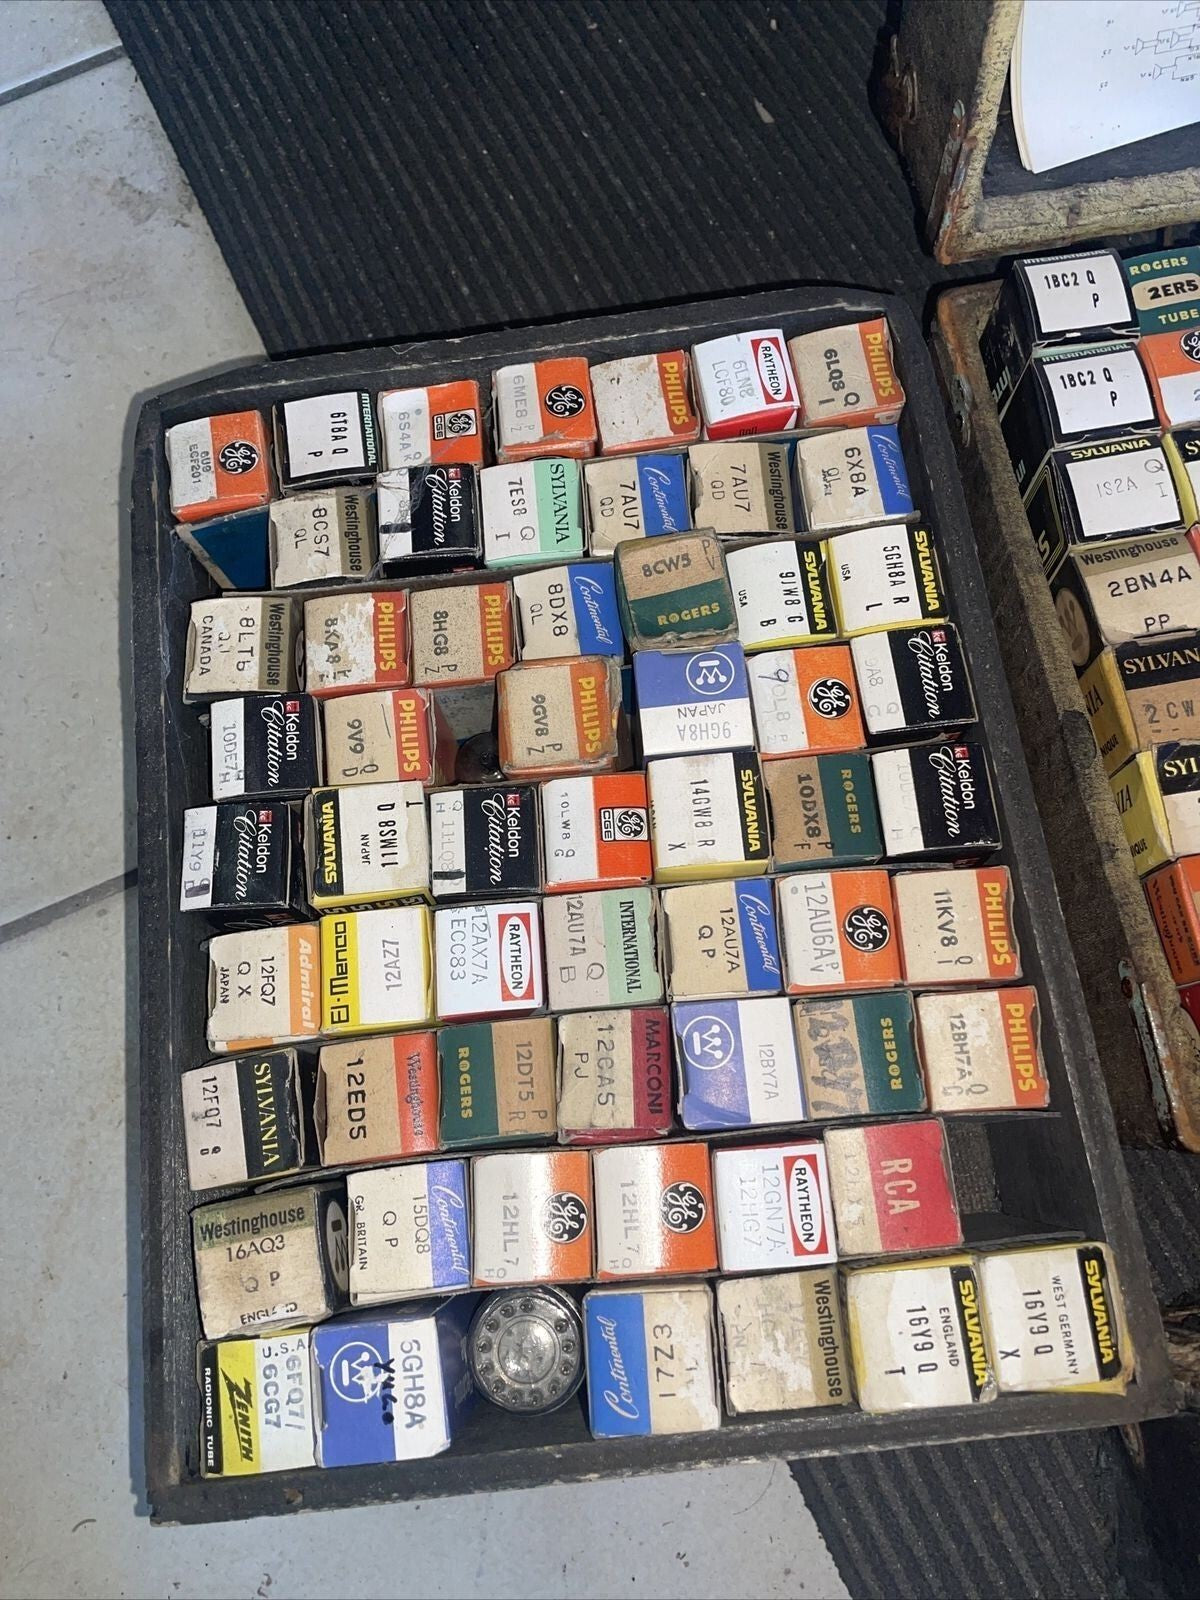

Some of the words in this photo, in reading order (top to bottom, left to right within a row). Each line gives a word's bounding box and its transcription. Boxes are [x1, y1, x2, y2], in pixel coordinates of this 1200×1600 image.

[1023, 250, 1109, 265] INTERNATIONAL
[1044, 272, 1080, 289] 1BC2
[1086, 270, 1096, 285] Q
[1129, 257, 1188, 275] ROGERS
[1092, 293, 1100, 307] P
[1148, 280, 1199, 300] 2ER5
[1158, 309, 1199, 324] TUBE
[761, 345, 782, 396] RAYTHEON
[824, 348, 845, 392] 6LQ8
[866, 332, 895, 397] PHILIPS
[1042, 343, 1131, 363] INTERNATIONAL
[1060, 370, 1097, 389] 1BC2
[1103, 368, 1113, 382] Q
[514, 375, 528, 417] 6ME8
[662, 361, 688, 425] PHILIPS
[1110, 391, 1118, 406] P
[330, 411, 346, 442] 6T8A
[332, 447, 348, 455] Q
[361, 393, 376, 466] INTERNATIONAL
[399, 411, 411, 452] 6S4A
[434, 415, 444, 439] CGE
[1071, 438, 1151, 459] SYLVANIA
[189, 444, 201, 486] ECF201
[711, 479, 725, 501] QD
[731, 464, 751, 512] 7AU7
[767, 452, 787, 530] Westinghouse
[844, 446, 868, 498] 6X8A
[872, 434, 910, 498] Continental
[425, 468, 447, 546] Citation
[448, 480, 461, 522] Keldon
[508, 478, 527, 515] 7ES8
[550, 463, 569, 544] SYLVANIA
[598, 496, 613, 518] QD
[619, 481, 639, 530] 7AU7
[643, 467, 679, 533] Continental
[294, 528, 307, 550] QL
[312, 508, 330, 557] 8CS7
[344, 494, 363, 571] Westinghouse
[1080, 536, 1178, 566] Westinghouse
[642, 554, 691, 577] 8CW5
[779, 571, 800, 606] 9JW8
[803, 551, 829, 630] SYLVANIA
[841, 564, 851, 582] USA
[883, 546, 906, 587] 5GH8A
[914, 531, 939, 611] SYLVANIA
[1108, 565, 1192, 597] 2BN4A
[530, 604, 545, 625] QL
[548, 583, 568, 637] 8DX8
[574, 576, 612, 645] Continental
[657, 602, 720, 626] ROGERS
[738, 589, 747, 608] USA
[1143, 614, 1170, 632] PP
[199, 615, 214, 676] CANADA
[269, 602, 286, 686] Westinghouse
[324, 618, 341, 665] 8KA8
[378, 601, 396, 671] PHILIPS
[432, 610, 448, 656] 8HG8
[484, 594, 504, 665] PHILIPS
[908, 631, 940, 718] Citation
[934, 643, 953, 692] Keldon
[286, 714, 299, 761] Keldon
[347, 719, 365, 754] 9V9
[399, 700, 422, 772] PHILIPS
[530, 694, 550, 741] 9GV8
[578, 676, 601, 754] PHILIPS
[677, 703, 726, 720] JAPAN
[677, 722, 733, 741] 9GH8A
[222, 723, 238, 775] 10DE7
[261, 702, 281, 787] Citation
[377, 803, 395, 811] Q
[690, 778, 712, 835] 14GW8
[740, 768, 762, 852] SYLVANIA
[797, 773, 822, 839] 10DX8
[841, 769, 861, 834] ROGERS
[929, 747, 960, 839] Citation
[954, 758, 975, 811] Keldon
[322, 801, 336, 884] SYLVANIA
[482, 794, 505, 885] Citation
[507, 807, 521, 858] Keldon
[559, 792, 571, 841] 10LW8
[602, 810, 613, 839] CGE
[234, 810, 250, 901] Citation
[258, 824, 272, 874] Keldon
[361, 833, 371, 865] JAPAN
[379, 819, 398, 868] 11MS8
[719, 908, 739, 973] 12AU7A
[740, 894, 779, 977] Continental
[804, 883, 835, 959] 12AU6A
[932, 887, 958, 948] 11KV8
[983, 881, 1011, 967] PHILIPS
[237, 960, 251, 975] Q
[383, 939, 400, 991] 12AZ7
[450, 918, 466, 981] ECC83
[508, 923, 523, 990] RAYTHEON
[619, 900, 642, 994] INTERNATIONAL
[220, 967, 231, 1004] JAPAN
[238, 985, 252, 996] X
[260, 956, 276, 1006] 12FQ7
[297, 938, 315, 1029] Admiral
[573, 1050, 589, 1079] PJ
[644, 1018, 663, 1115] MARCONI
[890, 1017, 904, 1090] ROGERS
[948, 1013, 968, 1082] 12BH7A
[1005, 1003, 1037, 1093] PHILIPS
[346, 1057, 367, 1140] 12ED5
[406, 1052, 424, 1138] Westinghouse
[458, 1046, 473, 1119] ROGERS
[515, 1040, 534, 1109] 12DT5
[201, 1075, 222, 1128] 12FQ7
[254, 1062, 280, 1166] SYLVANIA
[354, 1195, 364, 1213] GR.
[739, 1177, 760, 1247] 12HG7
[761, 1164, 784, 1252] 12GN7A
[794, 1166, 814, 1243] RAYTHEON
[880, 1157, 921, 1216] RCA
[200, 1206, 305, 1242] Westinghouse
[382, 1211, 396, 1226] Q
[385, 1238, 399, 1248] P
[412, 1194, 430, 1254] 15DQ8
[431, 1185, 471, 1276] Continental
[502, 1192, 519, 1266] 12HL7
[618, 1180, 640, 1254] 12HL7
[226, 1234, 286, 1262] 16AQ3
[356, 1222, 368, 1271] BRITAIN
[1022, 1289, 1049, 1336] 16Y9
[1052, 1275, 1068, 1309] WEST
[1084, 1259, 1113, 1364] SYLVANIA
[814, 1280, 843, 1397] Westinghouse
[906, 1305, 934, 1352] 16Y9
[939, 1307, 960, 1367] ENGLAND
[958, 1280, 986, 1386] SYLVANIA
[1034, 1344, 1053, 1355] Q
[1058, 1314, 1080, 1375] GERMANY
[400, 1340, 426, 1430] 5GH8A
[596, 1315, 640, 1419] Continental
[653, 1324, 673, 1398] 17Z3
[918, 1363, 938, 1373] Q
[204, 1367, 213, 1428] RADIONIC
[220, 1367, 253, 1462] ZENITH
[261, 1363, 282, 1428] 6CG7
[206, 1436, 215, 1466] TUBE
